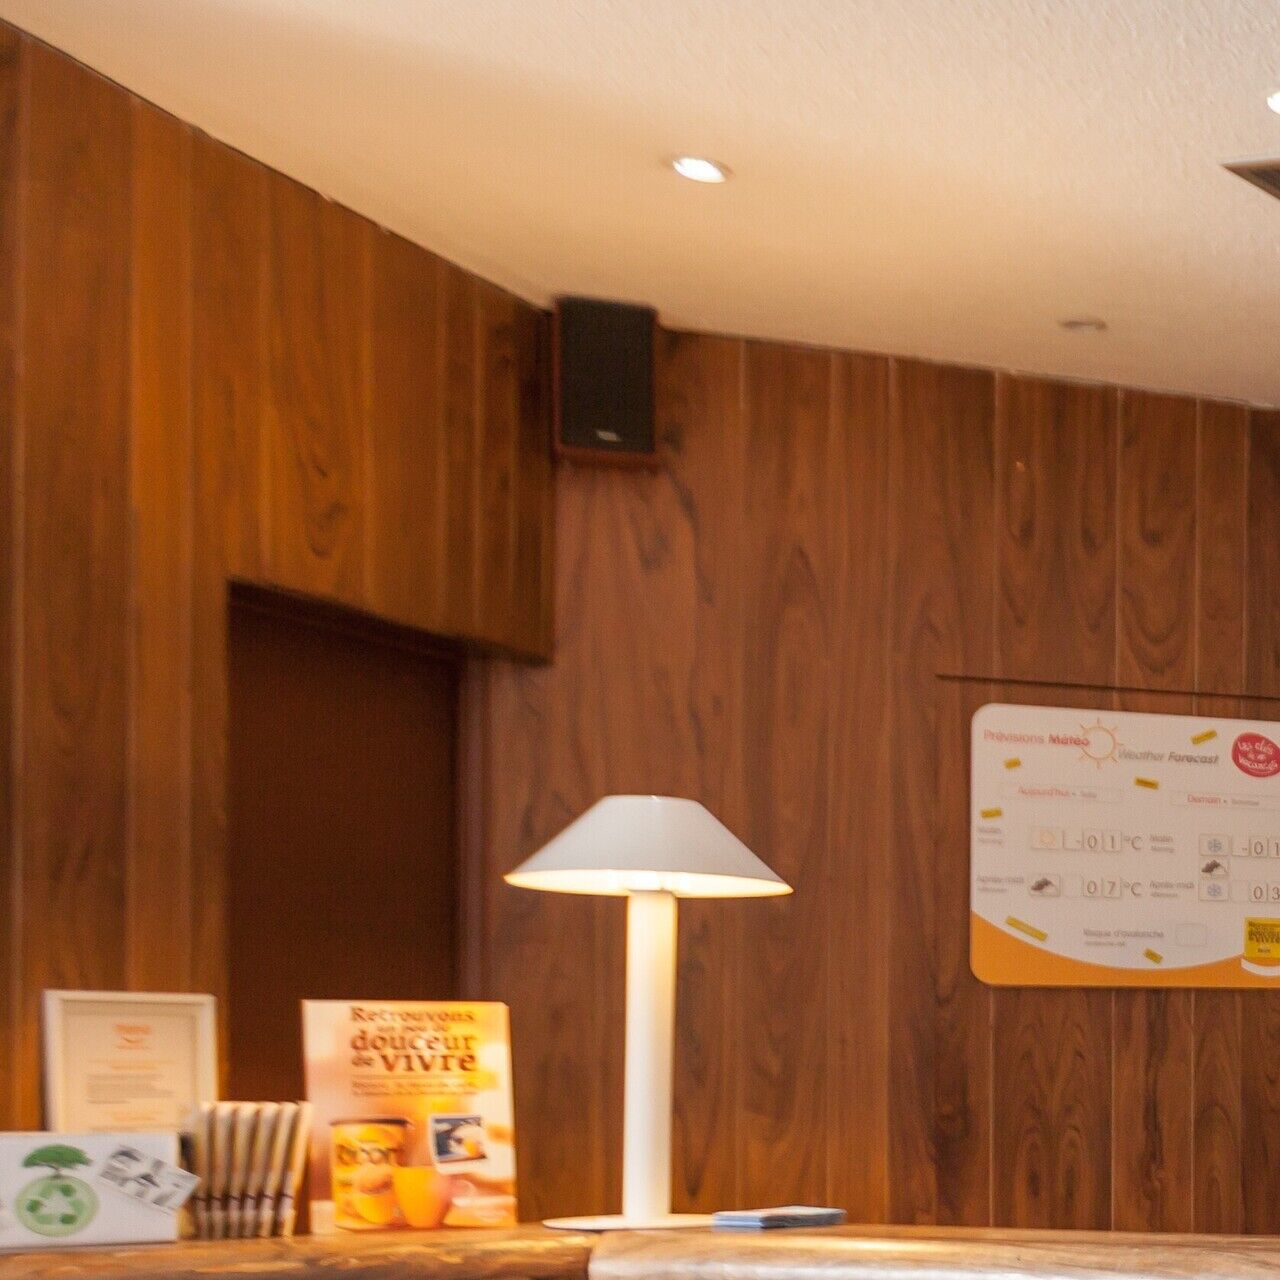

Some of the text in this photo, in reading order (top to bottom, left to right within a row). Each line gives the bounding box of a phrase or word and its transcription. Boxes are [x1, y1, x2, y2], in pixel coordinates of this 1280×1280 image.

[1168, 751, 1219, 765] Forecast
[351, 1007, 475, 1022] Retrouvons
[350, 1029, 477, 1051] douceur
[380, 1054, 477, 1072] vivre
